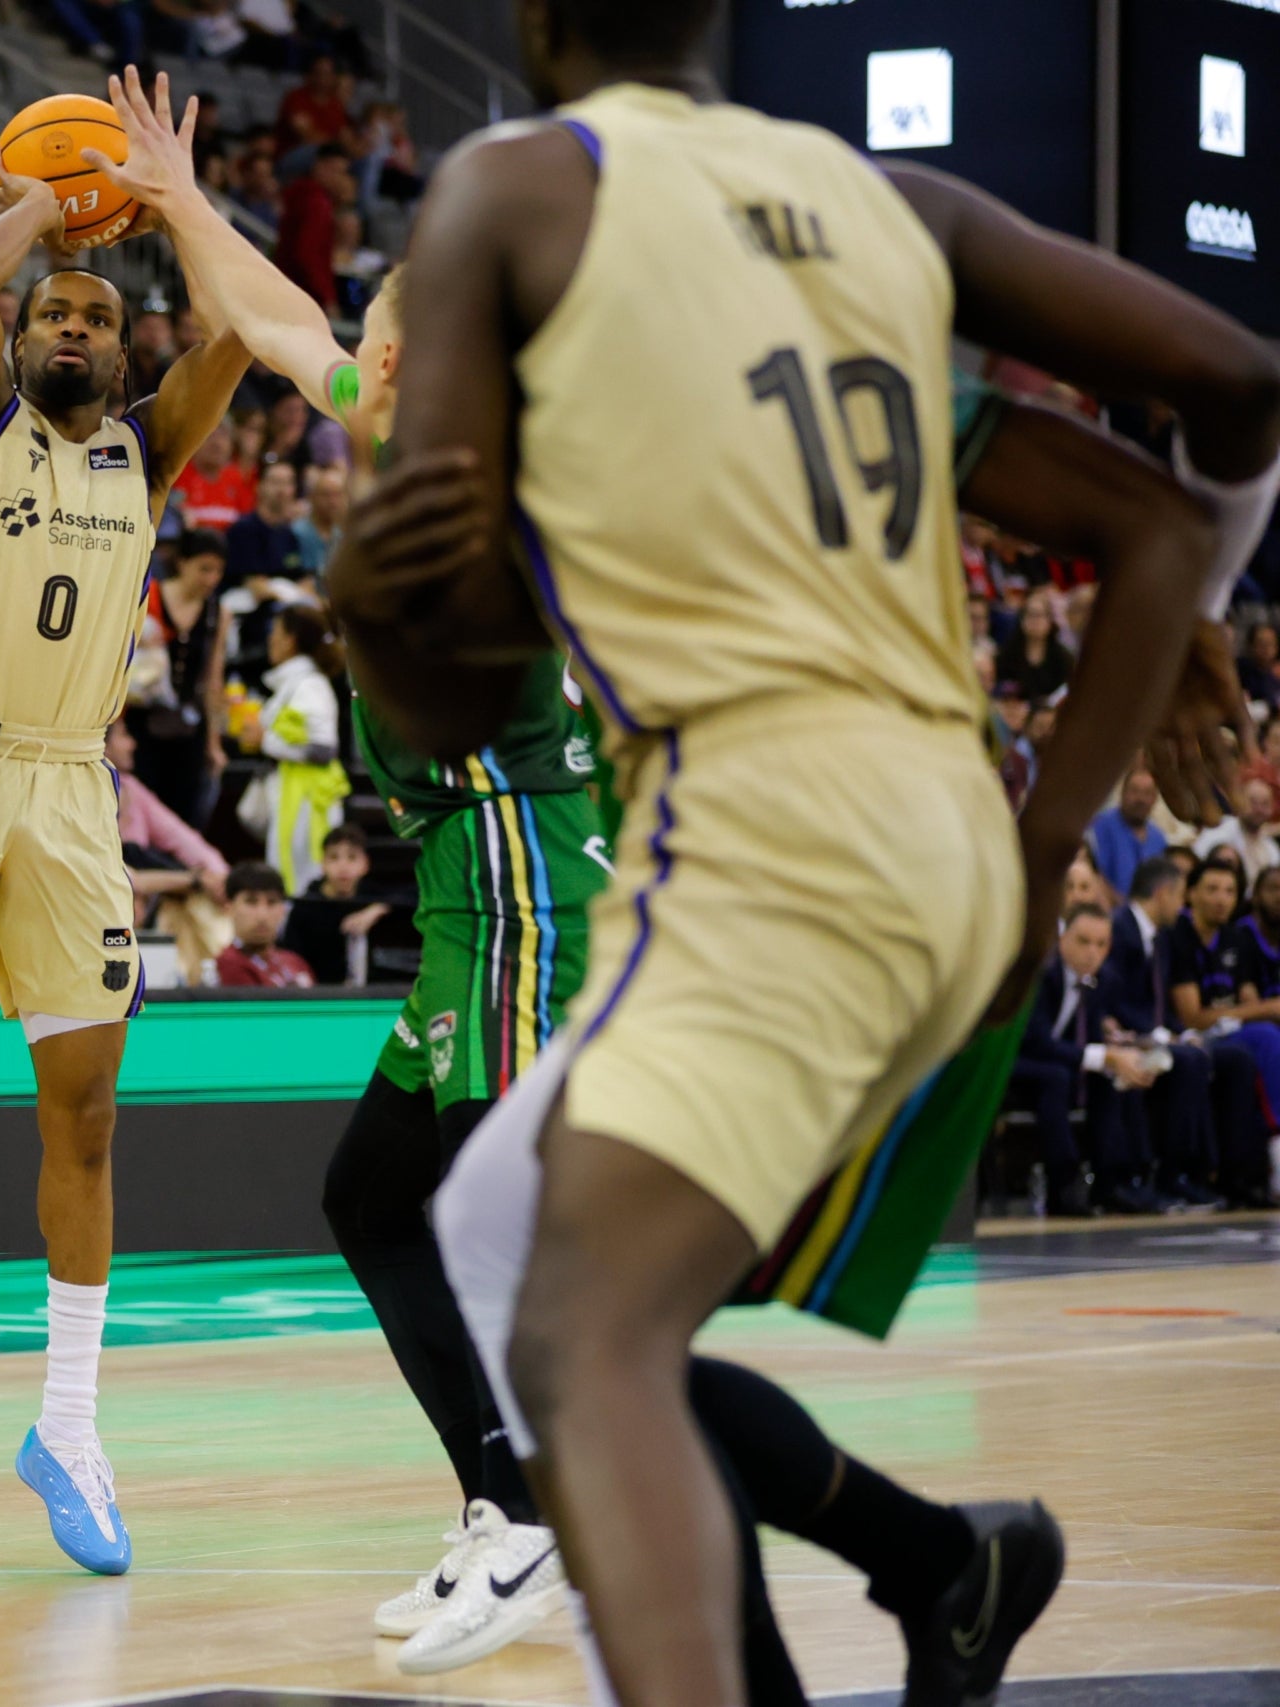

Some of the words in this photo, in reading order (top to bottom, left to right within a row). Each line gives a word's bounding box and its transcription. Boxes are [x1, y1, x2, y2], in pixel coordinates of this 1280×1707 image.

[57, 189, 99, 214] EV
[744, 347, 923, 561] 19
[48, 527, 112, 551] Santària
[37, 574, 79, 641] 0
[105, 935, 127, 945] acb
